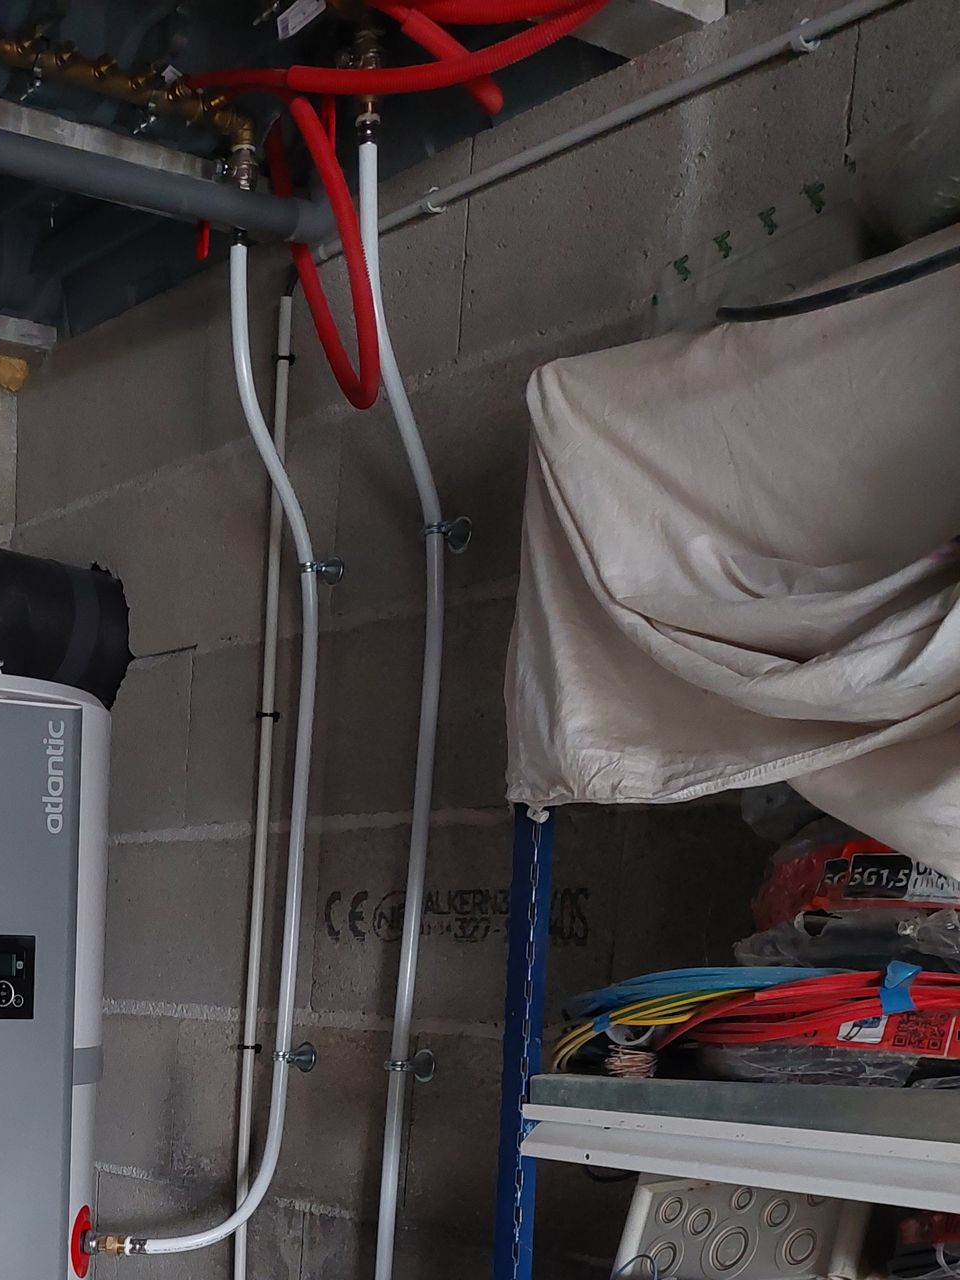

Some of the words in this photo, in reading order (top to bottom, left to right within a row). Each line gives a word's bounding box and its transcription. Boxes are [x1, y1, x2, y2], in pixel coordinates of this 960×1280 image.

[41, 720, 65, 834] atlantic
[848, 867, 910, 889] 5G1,5
[324, 890, 369, 941] CE
